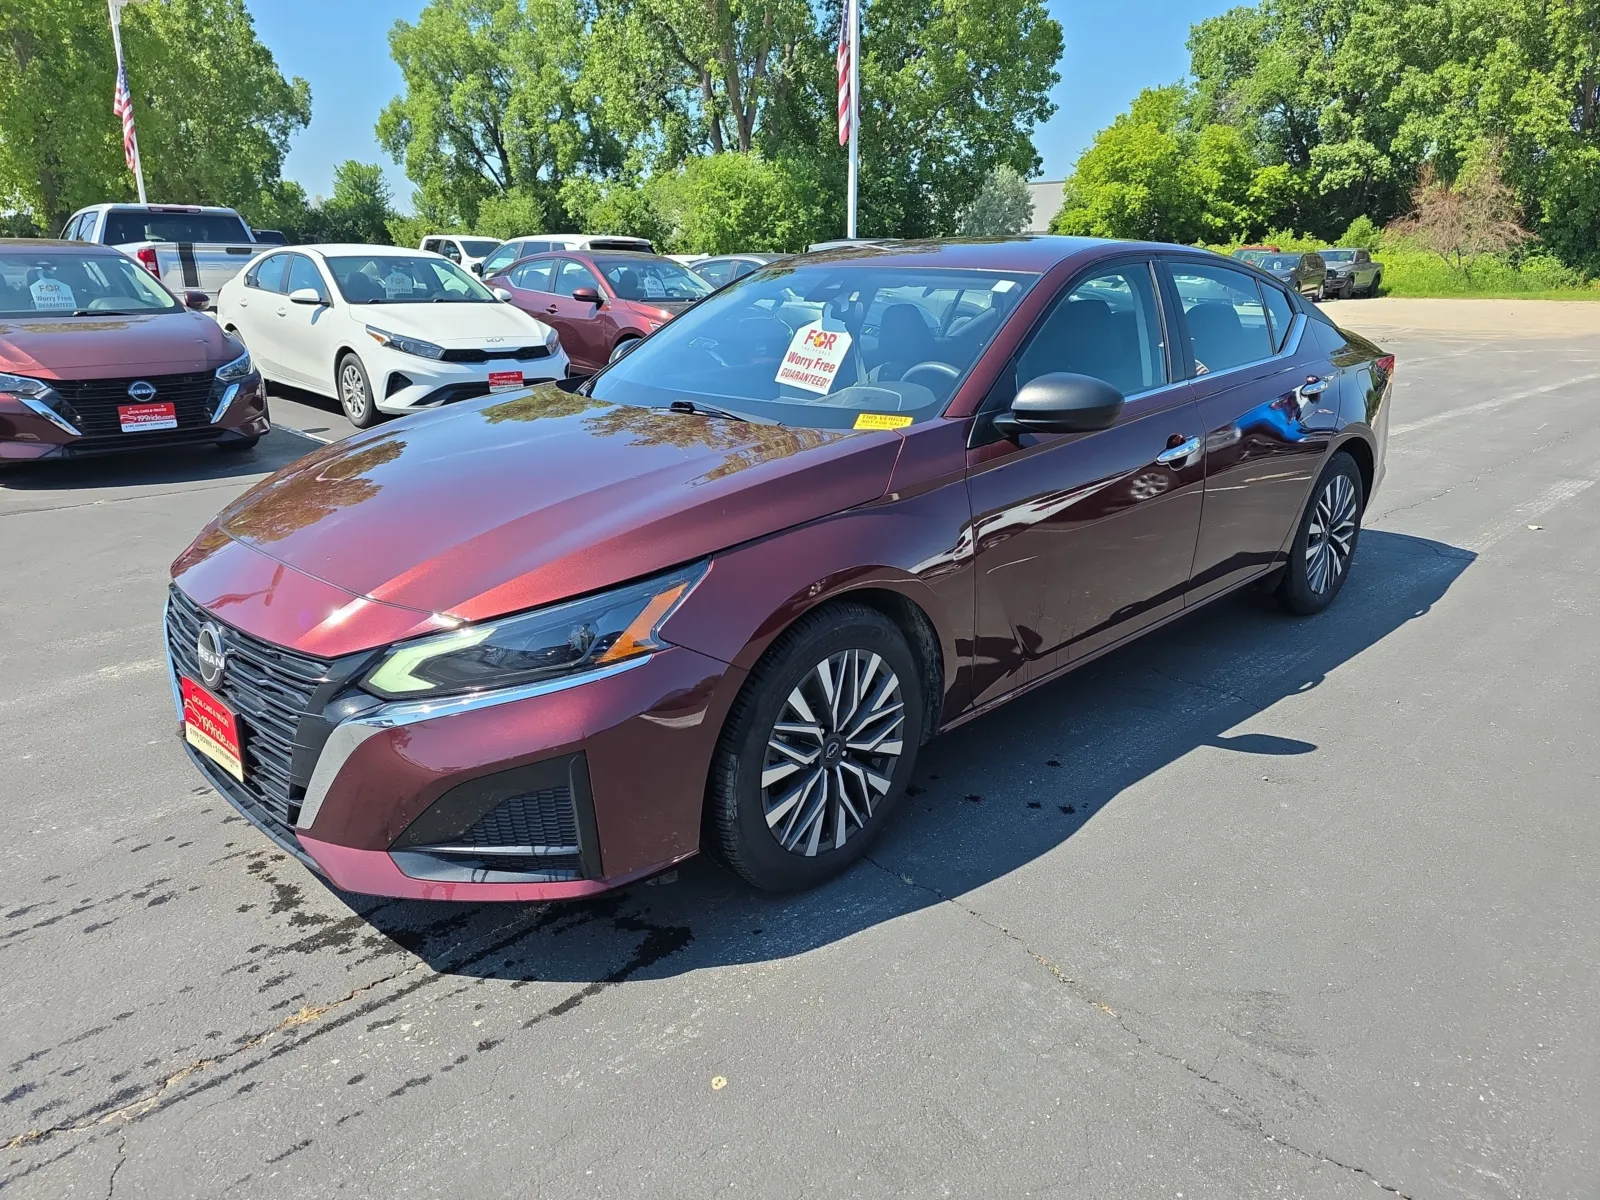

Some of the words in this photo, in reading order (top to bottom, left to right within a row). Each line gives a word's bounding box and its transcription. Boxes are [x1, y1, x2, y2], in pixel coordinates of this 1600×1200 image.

[39, 285, 61, 293] FOR
[804, 329, 837, 350] FOR
[812, 348, 831, 356] PEOPLE
[787, 351, 813, 370] Worry
[813, 357, 836, 373] Free
[780, 368, 831, 388] GUARANTEED!
[137, 414, 175, 422] 199ride.com
[192, 693, 204, 707] LOCAL
[200, 714, 239, 757] 199ride.com
